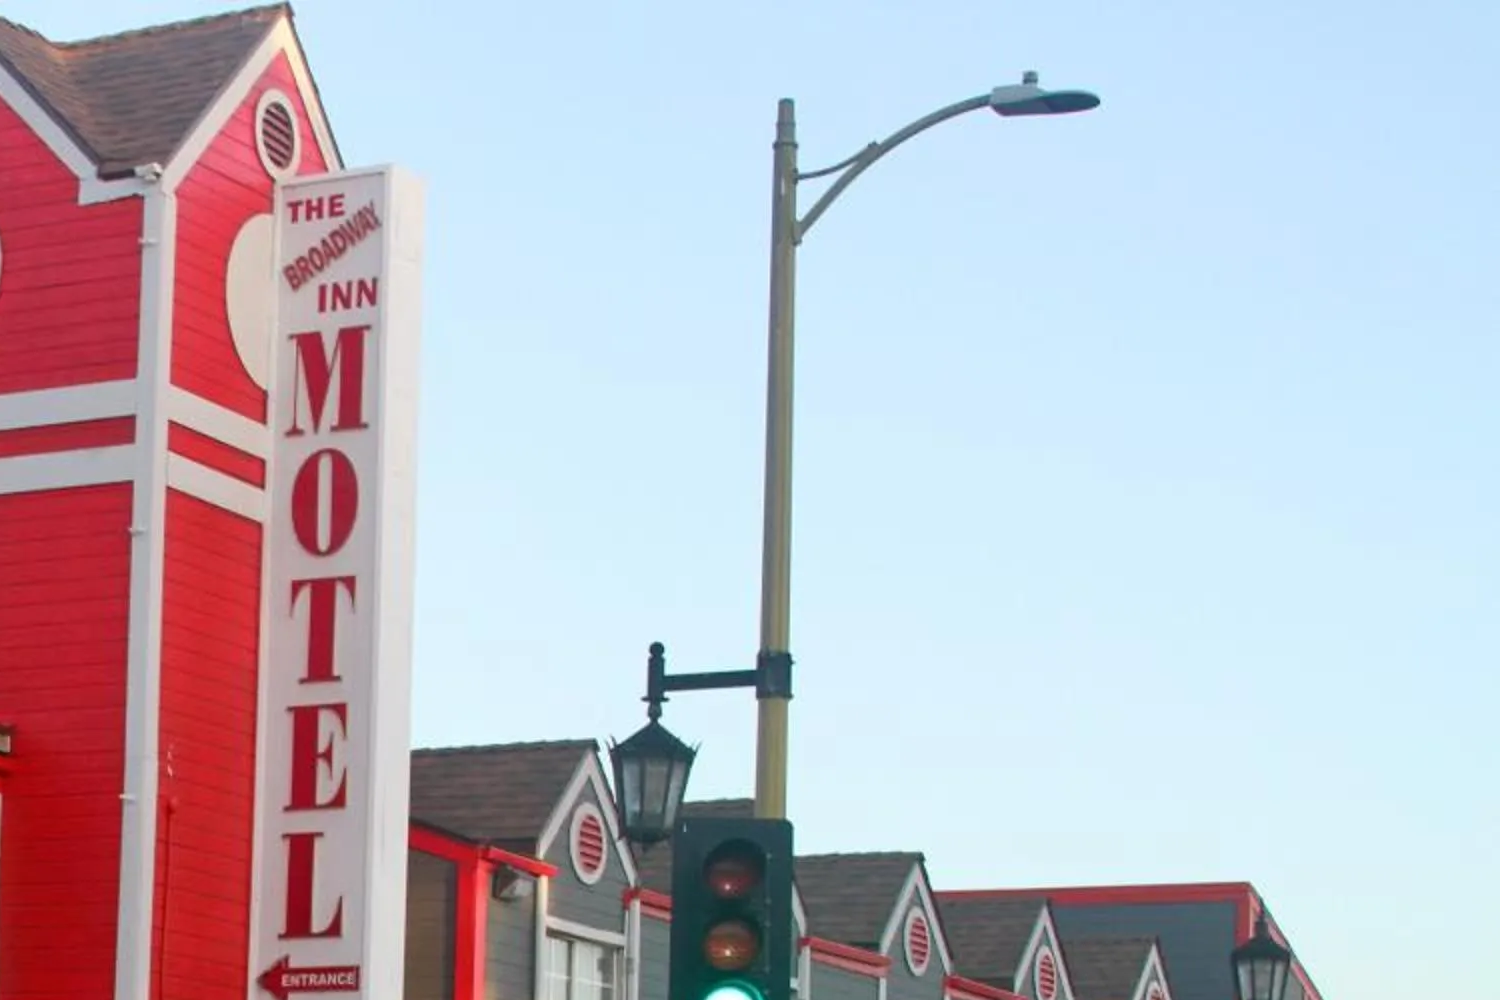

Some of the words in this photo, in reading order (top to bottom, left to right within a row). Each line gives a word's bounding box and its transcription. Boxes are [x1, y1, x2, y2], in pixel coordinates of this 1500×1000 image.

[287, 194, 346, 223] THE
[282, 202, 382, 291] BROADWAY
[317, 277, 379, 313] INN
[277, 325, 372, 939] MOTEL
[281, 972, 356, 987] ENTRANCE
